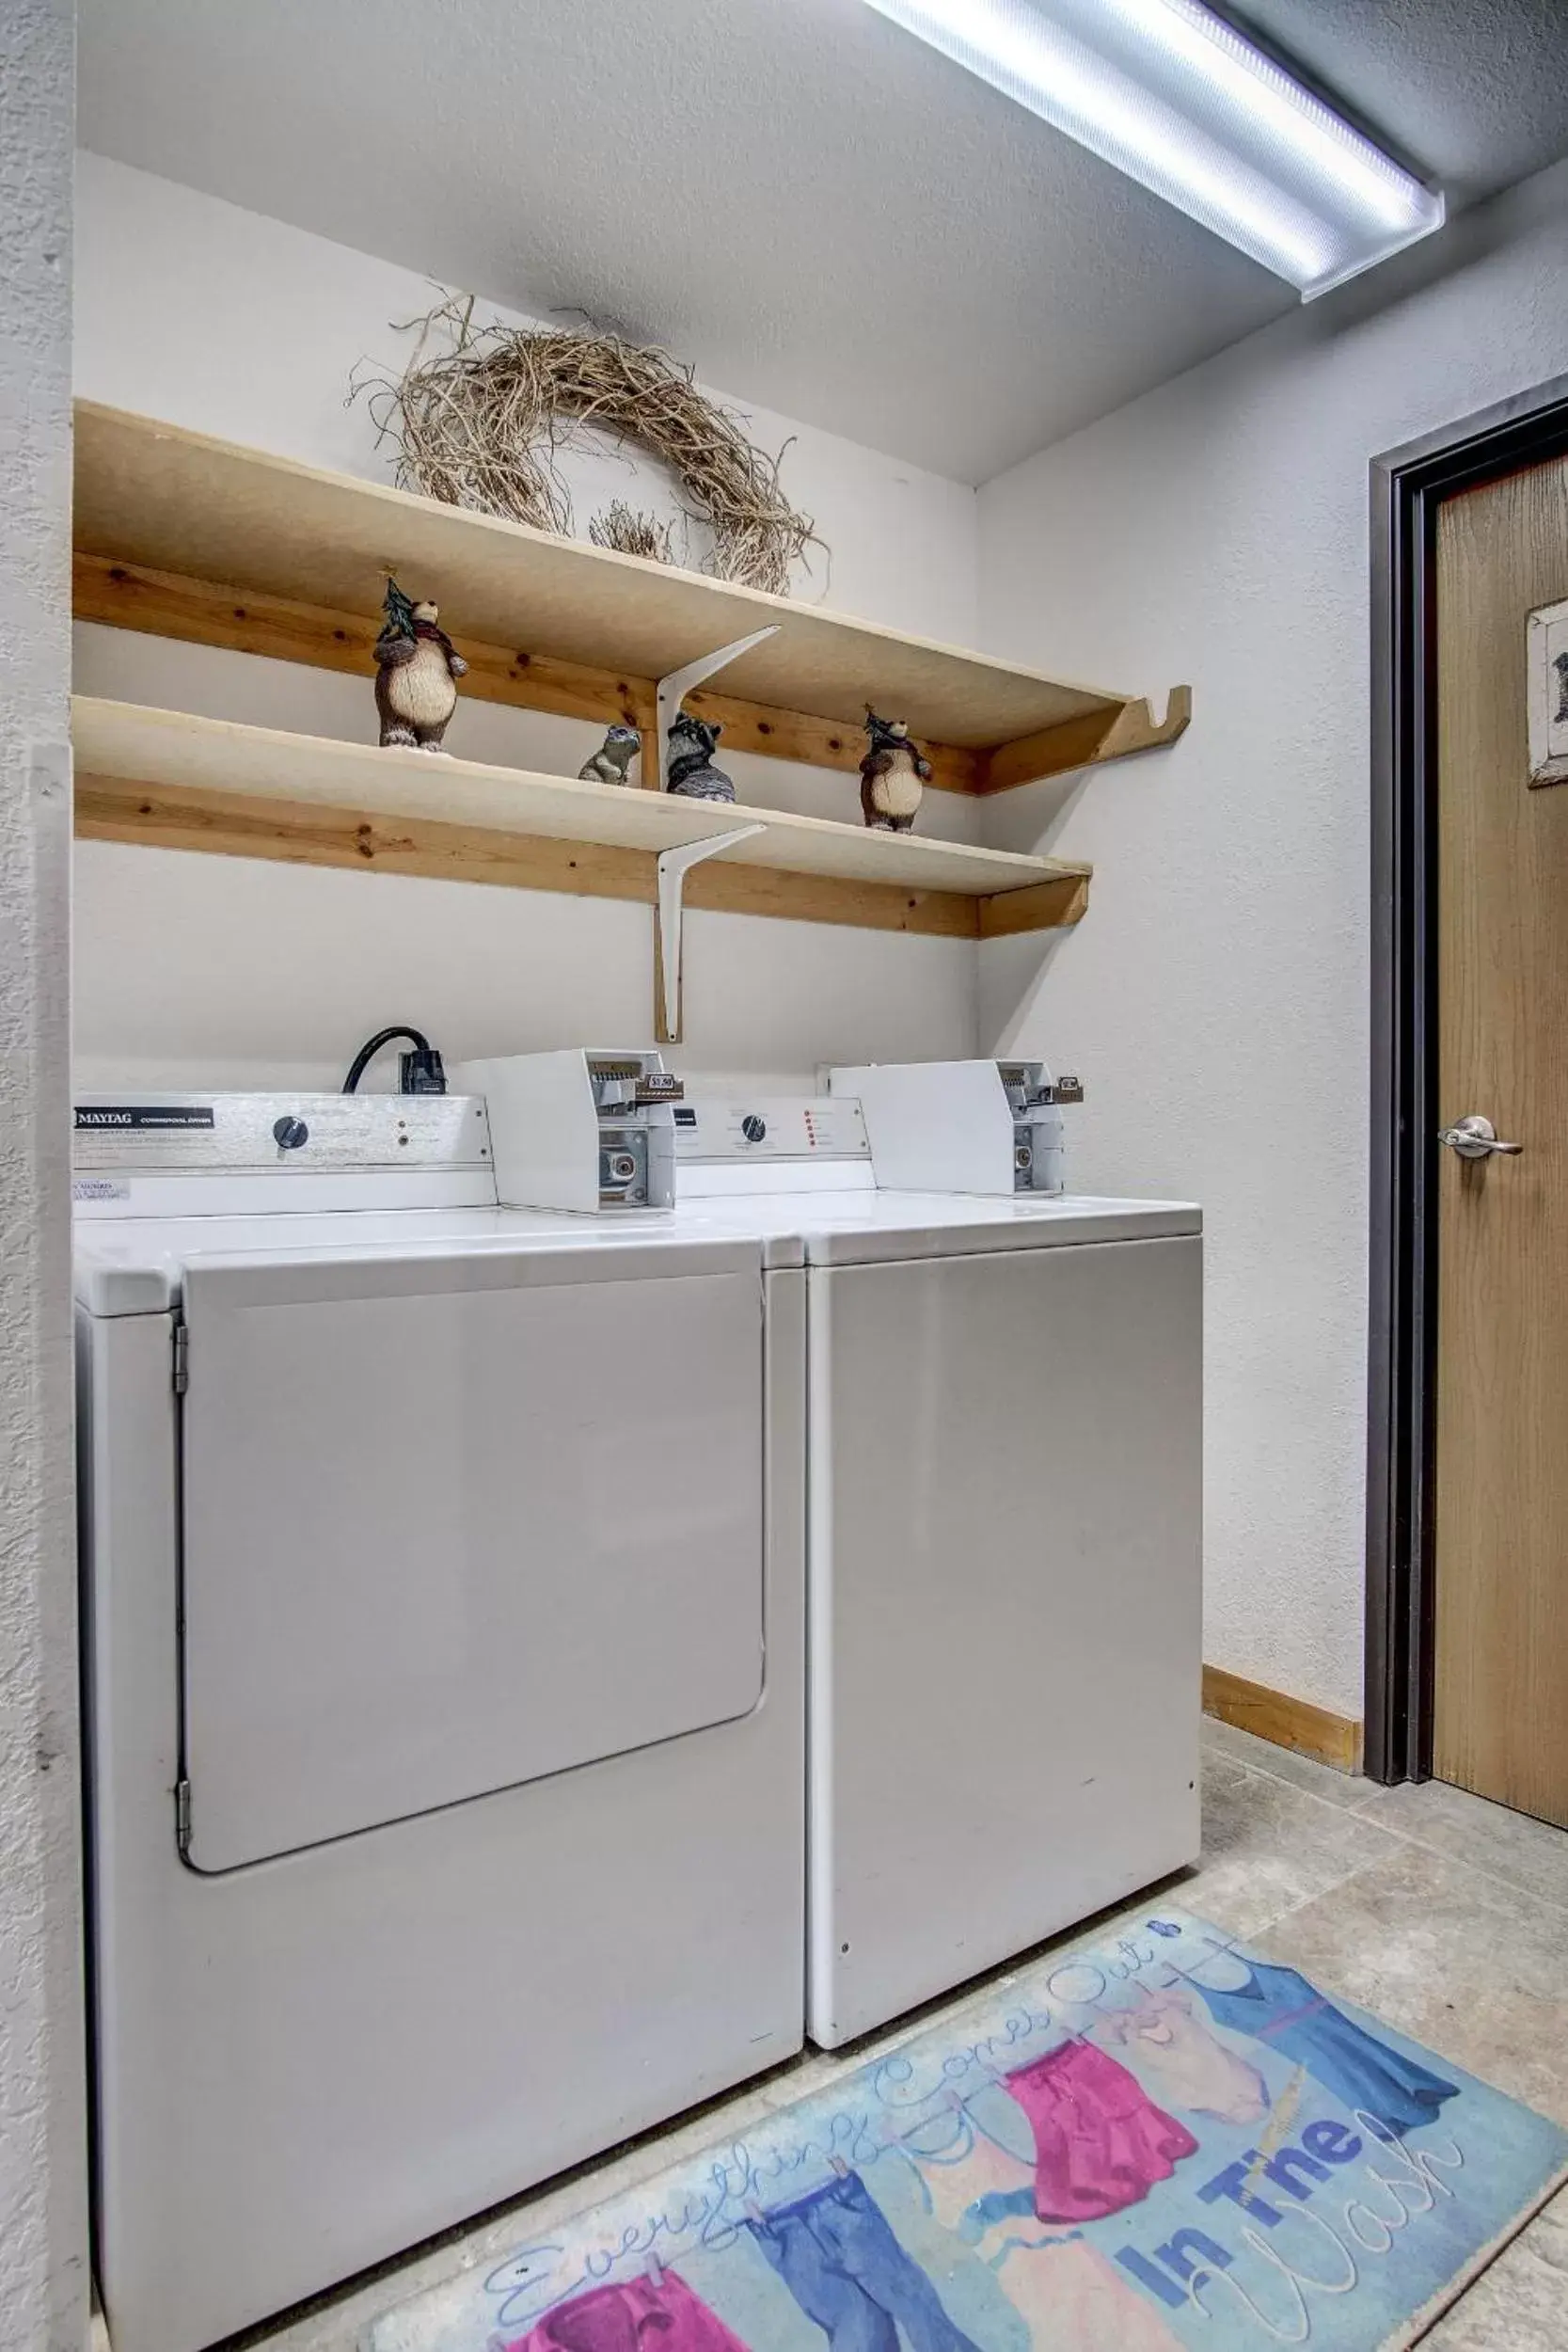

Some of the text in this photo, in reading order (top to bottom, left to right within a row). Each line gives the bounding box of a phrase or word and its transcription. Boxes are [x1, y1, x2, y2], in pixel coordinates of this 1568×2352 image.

[78, 1113, 132, 1123] MAYTAG
[483, 1940, 1154, 2328] Everything Comes Out
[1114, 2120, 1363, 2309] In The
[1188, 2108, 1465, 2342] Wash
